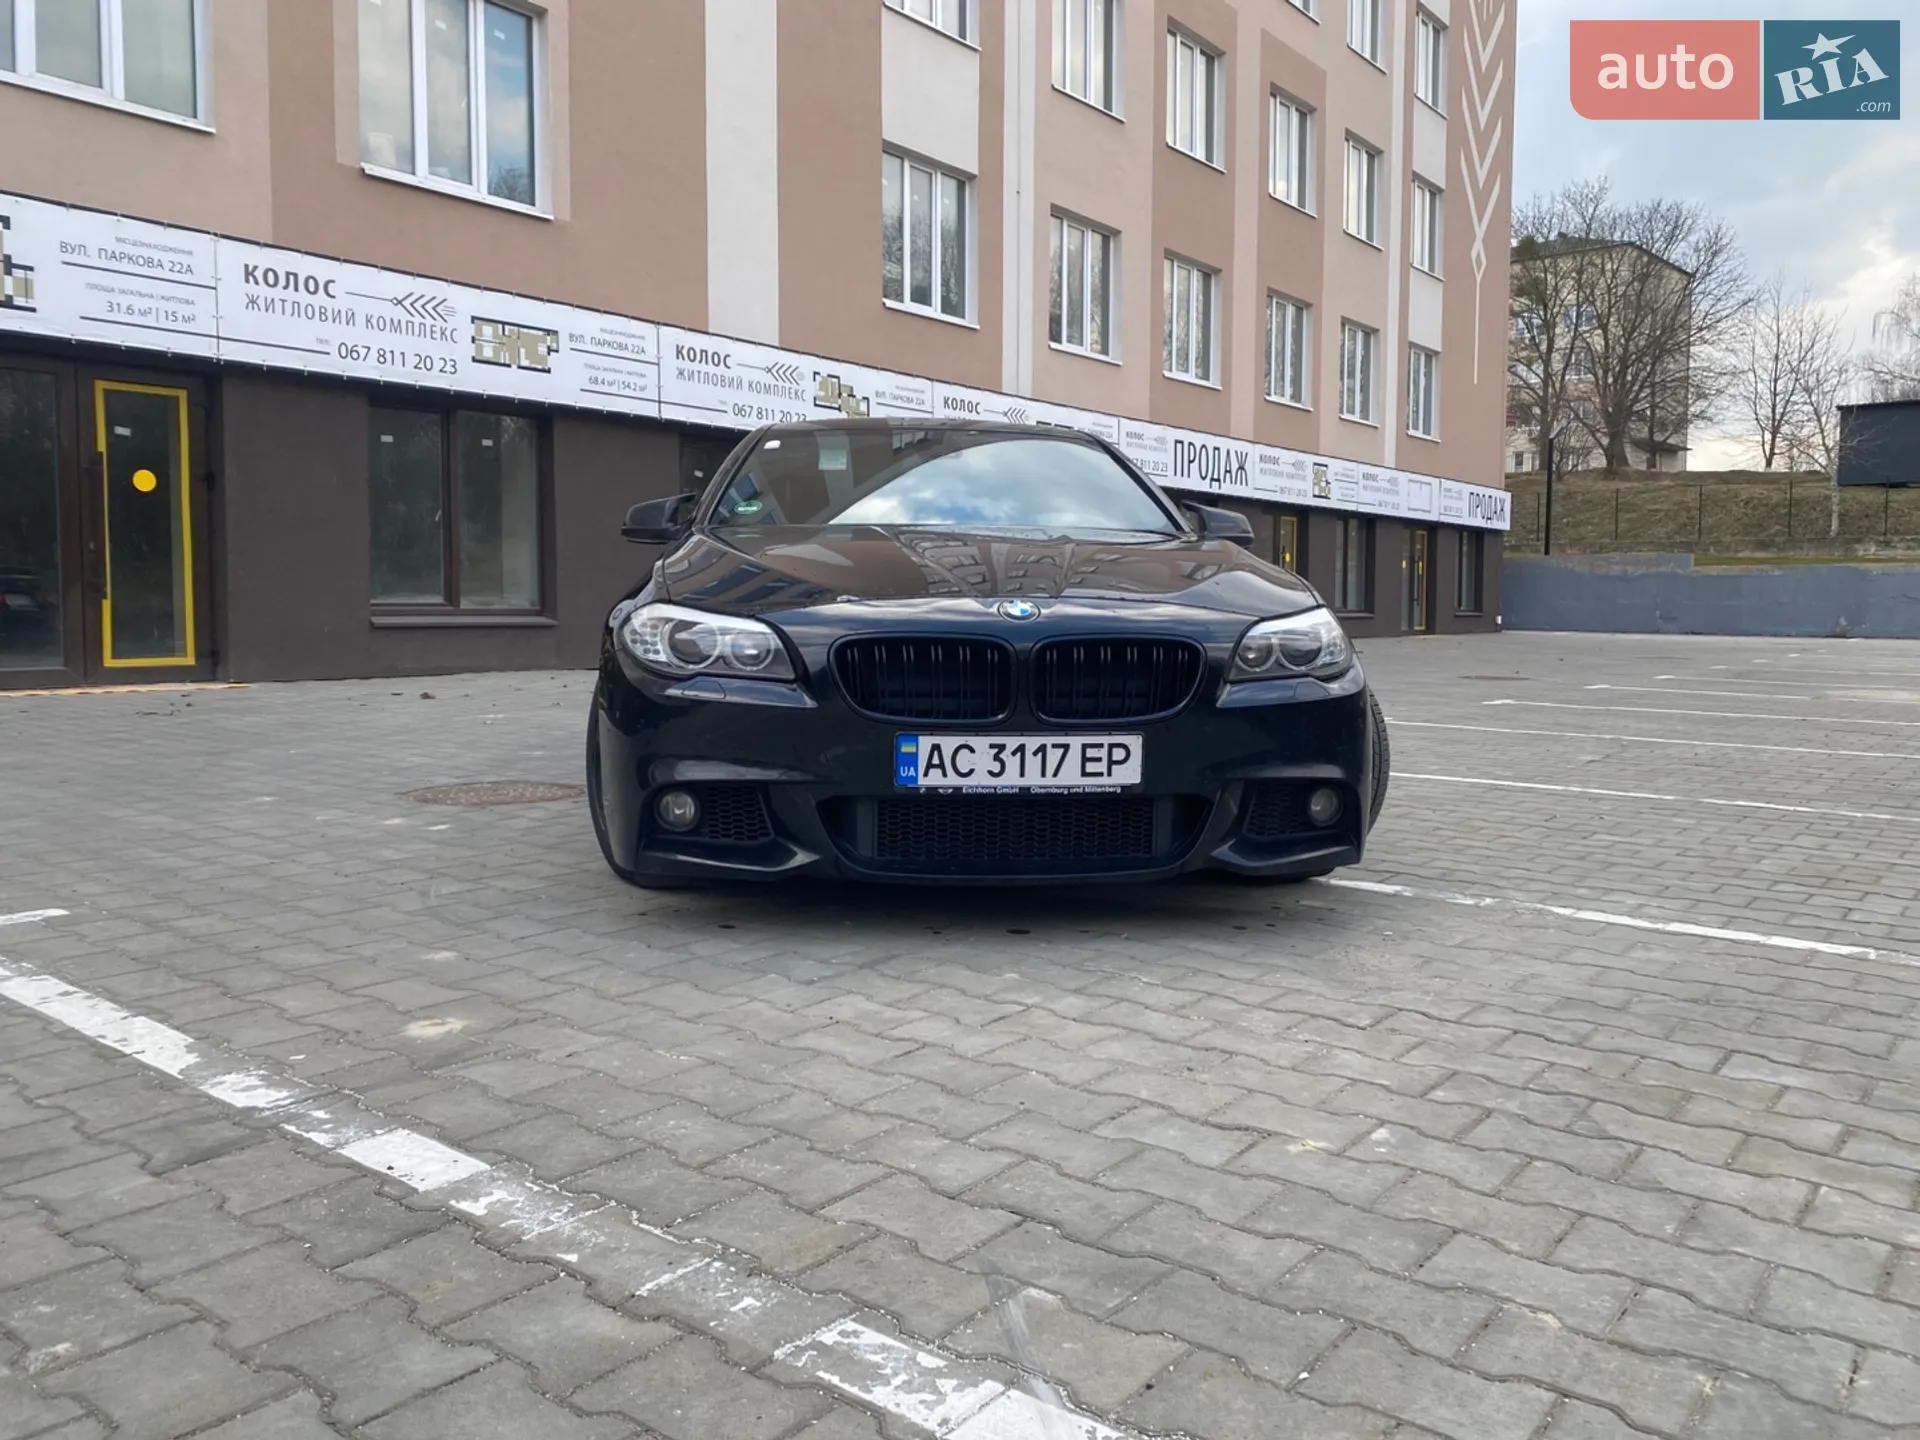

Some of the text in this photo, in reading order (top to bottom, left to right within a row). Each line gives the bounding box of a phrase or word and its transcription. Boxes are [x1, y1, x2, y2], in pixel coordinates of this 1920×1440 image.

[59, 240, 195, 276] ВУЛ. ПАРКОВА 22А
[243, 263, 337, 299] КОЛОС
[106, 300, 136, 316] 31.6
[163, 309, 179, 323] 15
[245, 292, 459, 344] ЖИТЛОВИЙ КОМПЛЕКС
[337, 341, 458, 376] 067 811 20 23
[590, 336, 630, 353] ПАРКОВА
[630, 343, 647, 356] 22А
[675, 343, 731, 370] КОЛОС
[588, 375, 606, 386] 68.4
[676, 366, 807, 402] ЖИТЛОВИЙ КОМПЛЕКС
[732, 403, 754, 418] 067
[756, 406, 776, 422] 811
[779, 410, 792, 423] 20
[943, 395, 982, 415] КОЛОС
[1173, 439, 1249, 490] ПРОДАЖ
[1468, 491, 1507, 524] ПРОДАЖ
[900, 766, 916, 777] UA
[922, 742, 1131, 778] AC 3117 EP
